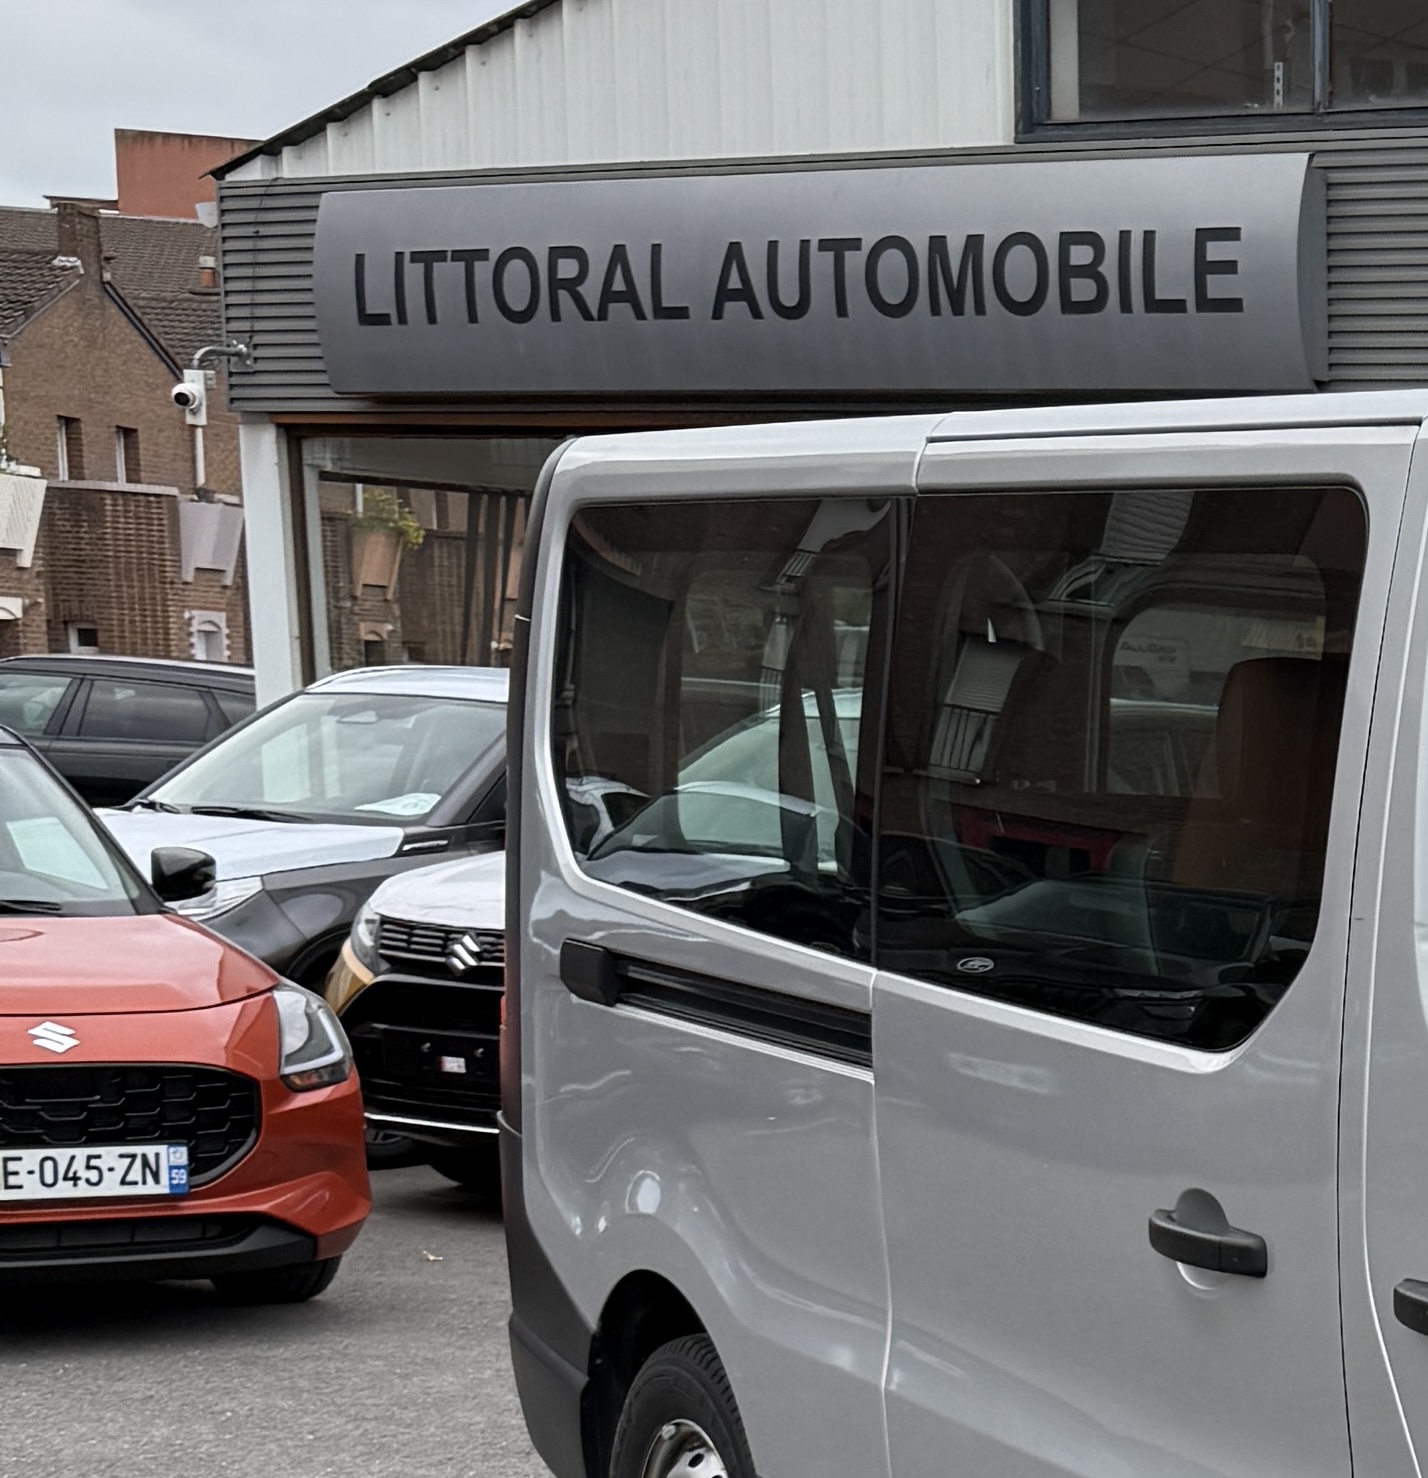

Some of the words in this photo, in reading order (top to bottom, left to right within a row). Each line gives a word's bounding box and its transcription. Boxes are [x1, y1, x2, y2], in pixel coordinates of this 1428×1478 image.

[353, 242, 690, 327] LITTORAL
[710, 226, 1245, 322] AUTOMOBILE
[2, 1152, 161, 1191] E-045-ZN
[171, 1168, 187, 1185] 59
